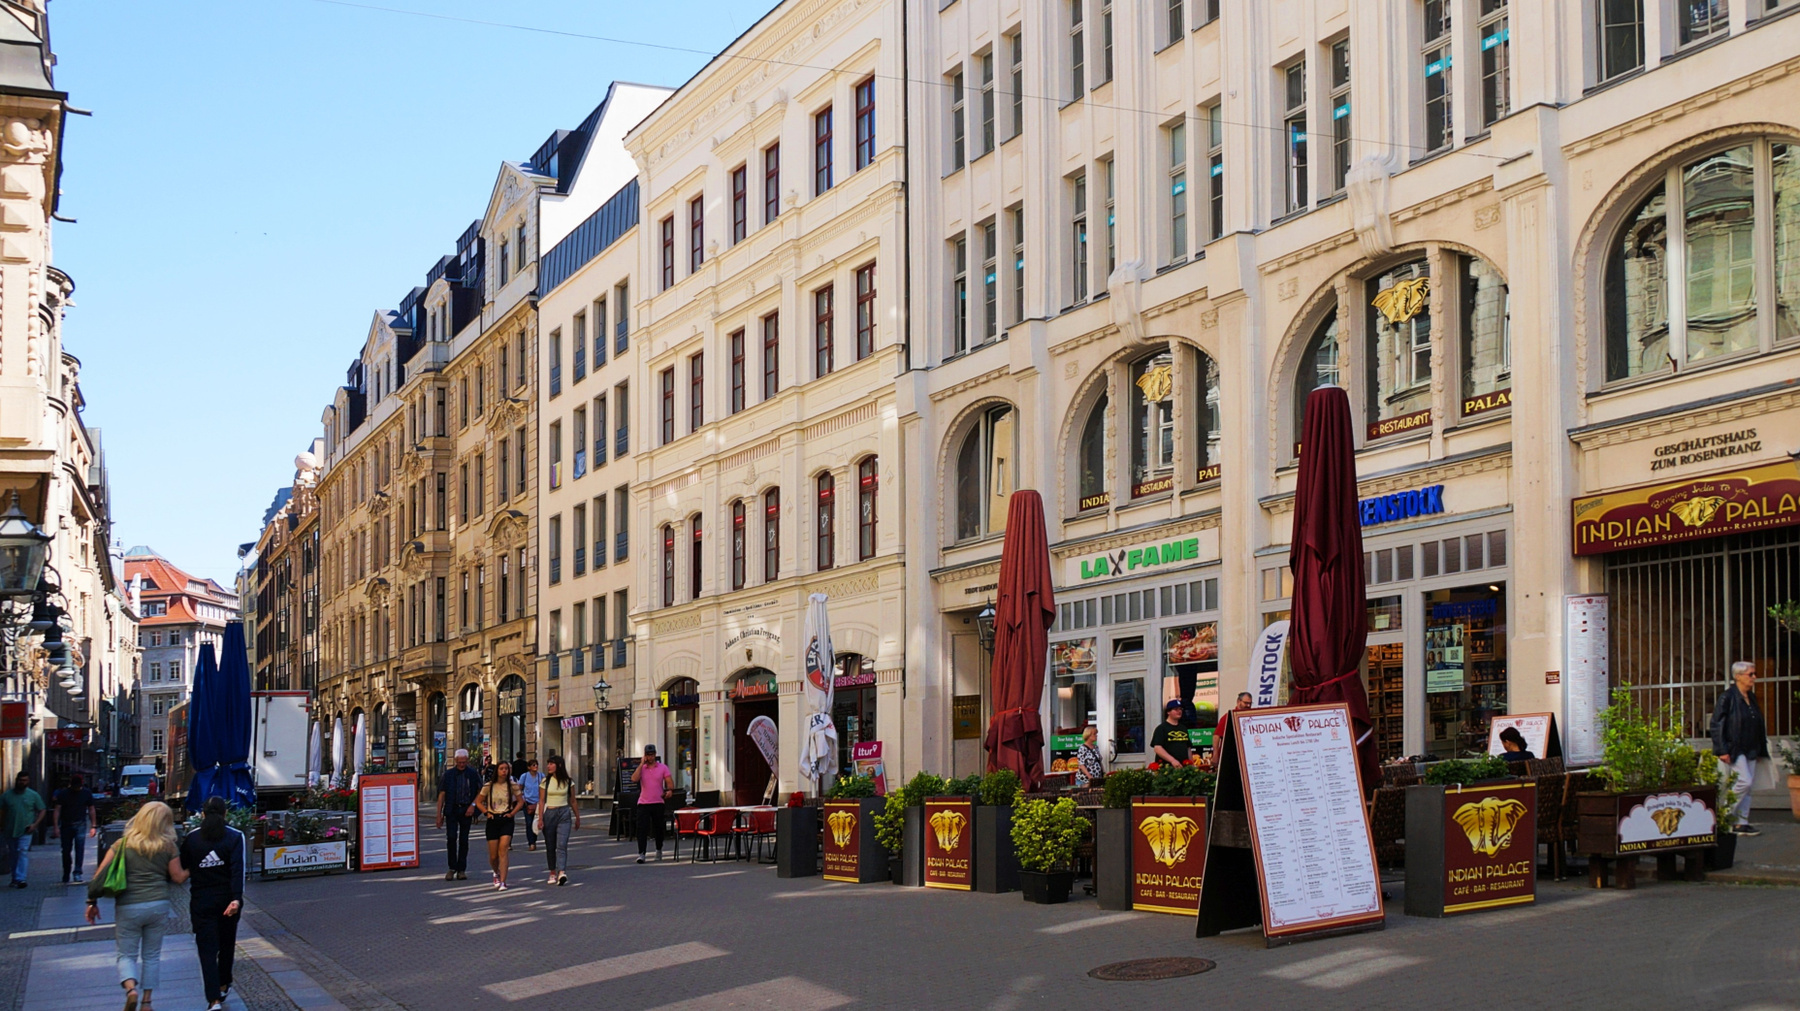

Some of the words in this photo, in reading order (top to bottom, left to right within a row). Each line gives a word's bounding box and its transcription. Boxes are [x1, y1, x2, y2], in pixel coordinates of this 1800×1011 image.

[1379, 411, 1430, 435] RESTAURANT
[1654, 427, 1757, 457] GESCHÄFTSHAUS
[1650, 457, 1677, 471] ZUM
[1679, 440, 1762, 465] ROSENKRANZ
[1651, 491, 1688, 509] Bringing
[1692, 483, 1714, 494] India
[1582, 512, 1671, 544] INDIAN
[1614, 536, 1658, 548] Indisches
[1662, 516, 1792, 541] Spezialitäten-Restaurant
[1081, 556, 1110, 579] LA
[1128, 537, 1199, 570] FAME
[561, 716, 585, 729] ANTIK
[1248, 722, 1282, 735] INDIAN
[1308, 717, 1341, 729] PALACE
[1619, 842, 1647, 851] INDIAN
[1687, 835, 1715, 844] PALACE
[199, 860, 225, 868] adidas
[284, 854, 317, 865] Indian
[825, 853, 840, 862] INDIAN
[839, 854, 858, 864] PALACE
[927, 857, 944, 867] INDIAN
[945, 858, 968, 869] PALACE
[299, 863, 343, 872] Spezialitäten
[1448, 866, 1482, 883] INDIAN
[1486, 861, 1530, 878] PALACE
[1136, 873, 1163, 886] INDIAN
[1165, 875, 1202, 889] PALACE
[1453, 885, 1469, 896] CAFÉ
[1473, 884, 1486, 893] BAR
[1490, 879, 1525, 891] RESAURANT
[1155, 890, 1166, 898] BAR
